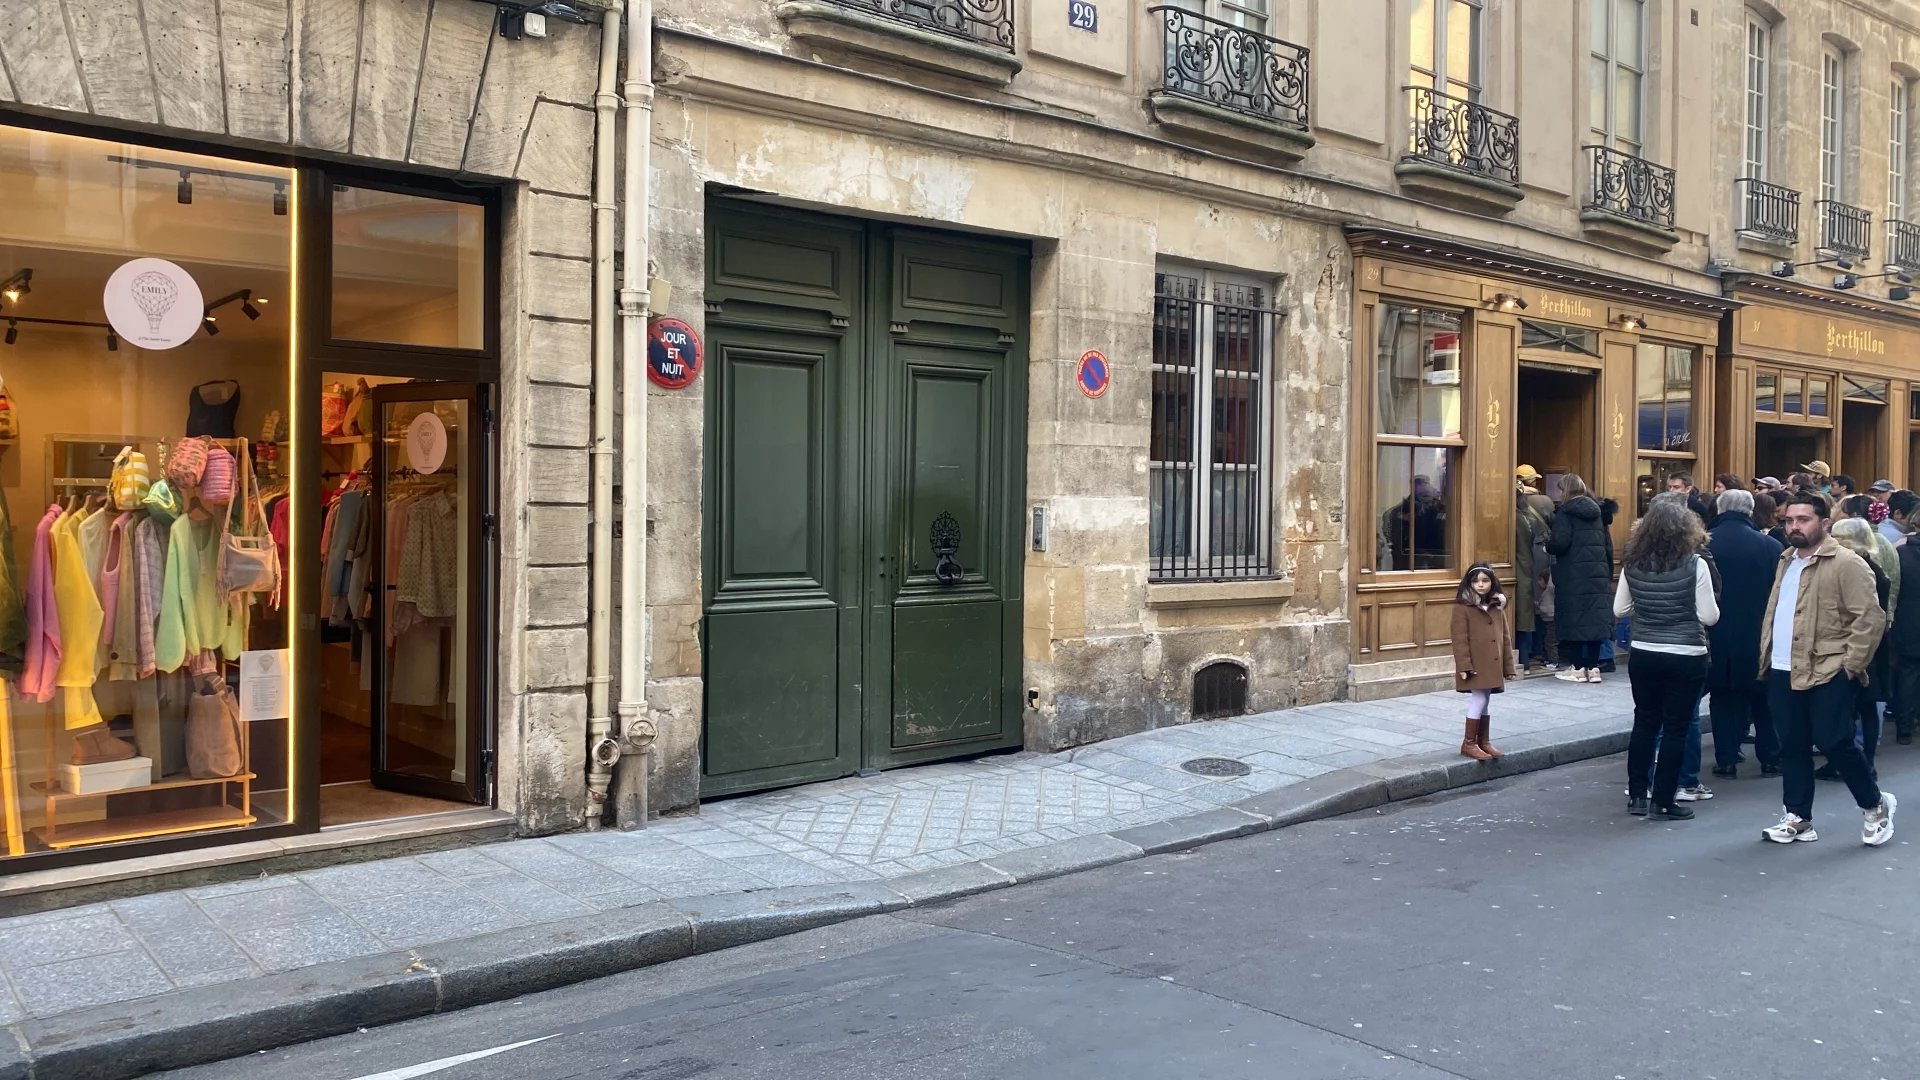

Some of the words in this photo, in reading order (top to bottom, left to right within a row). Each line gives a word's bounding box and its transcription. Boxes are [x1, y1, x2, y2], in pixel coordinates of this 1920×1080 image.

[1073, 3, 1094, 28] 29
[1367, 267, 1379, 281] 29
[141, 286, 167, 295] EMILY
[1540, 290, 1592, 318] Berthillon
[660, 331, 687, 345] JOUR
[1827, 320, 1885, 357] Berthillon
[667, 347, 681, 360] ET
[661, 362, 685, 376] NUIT
